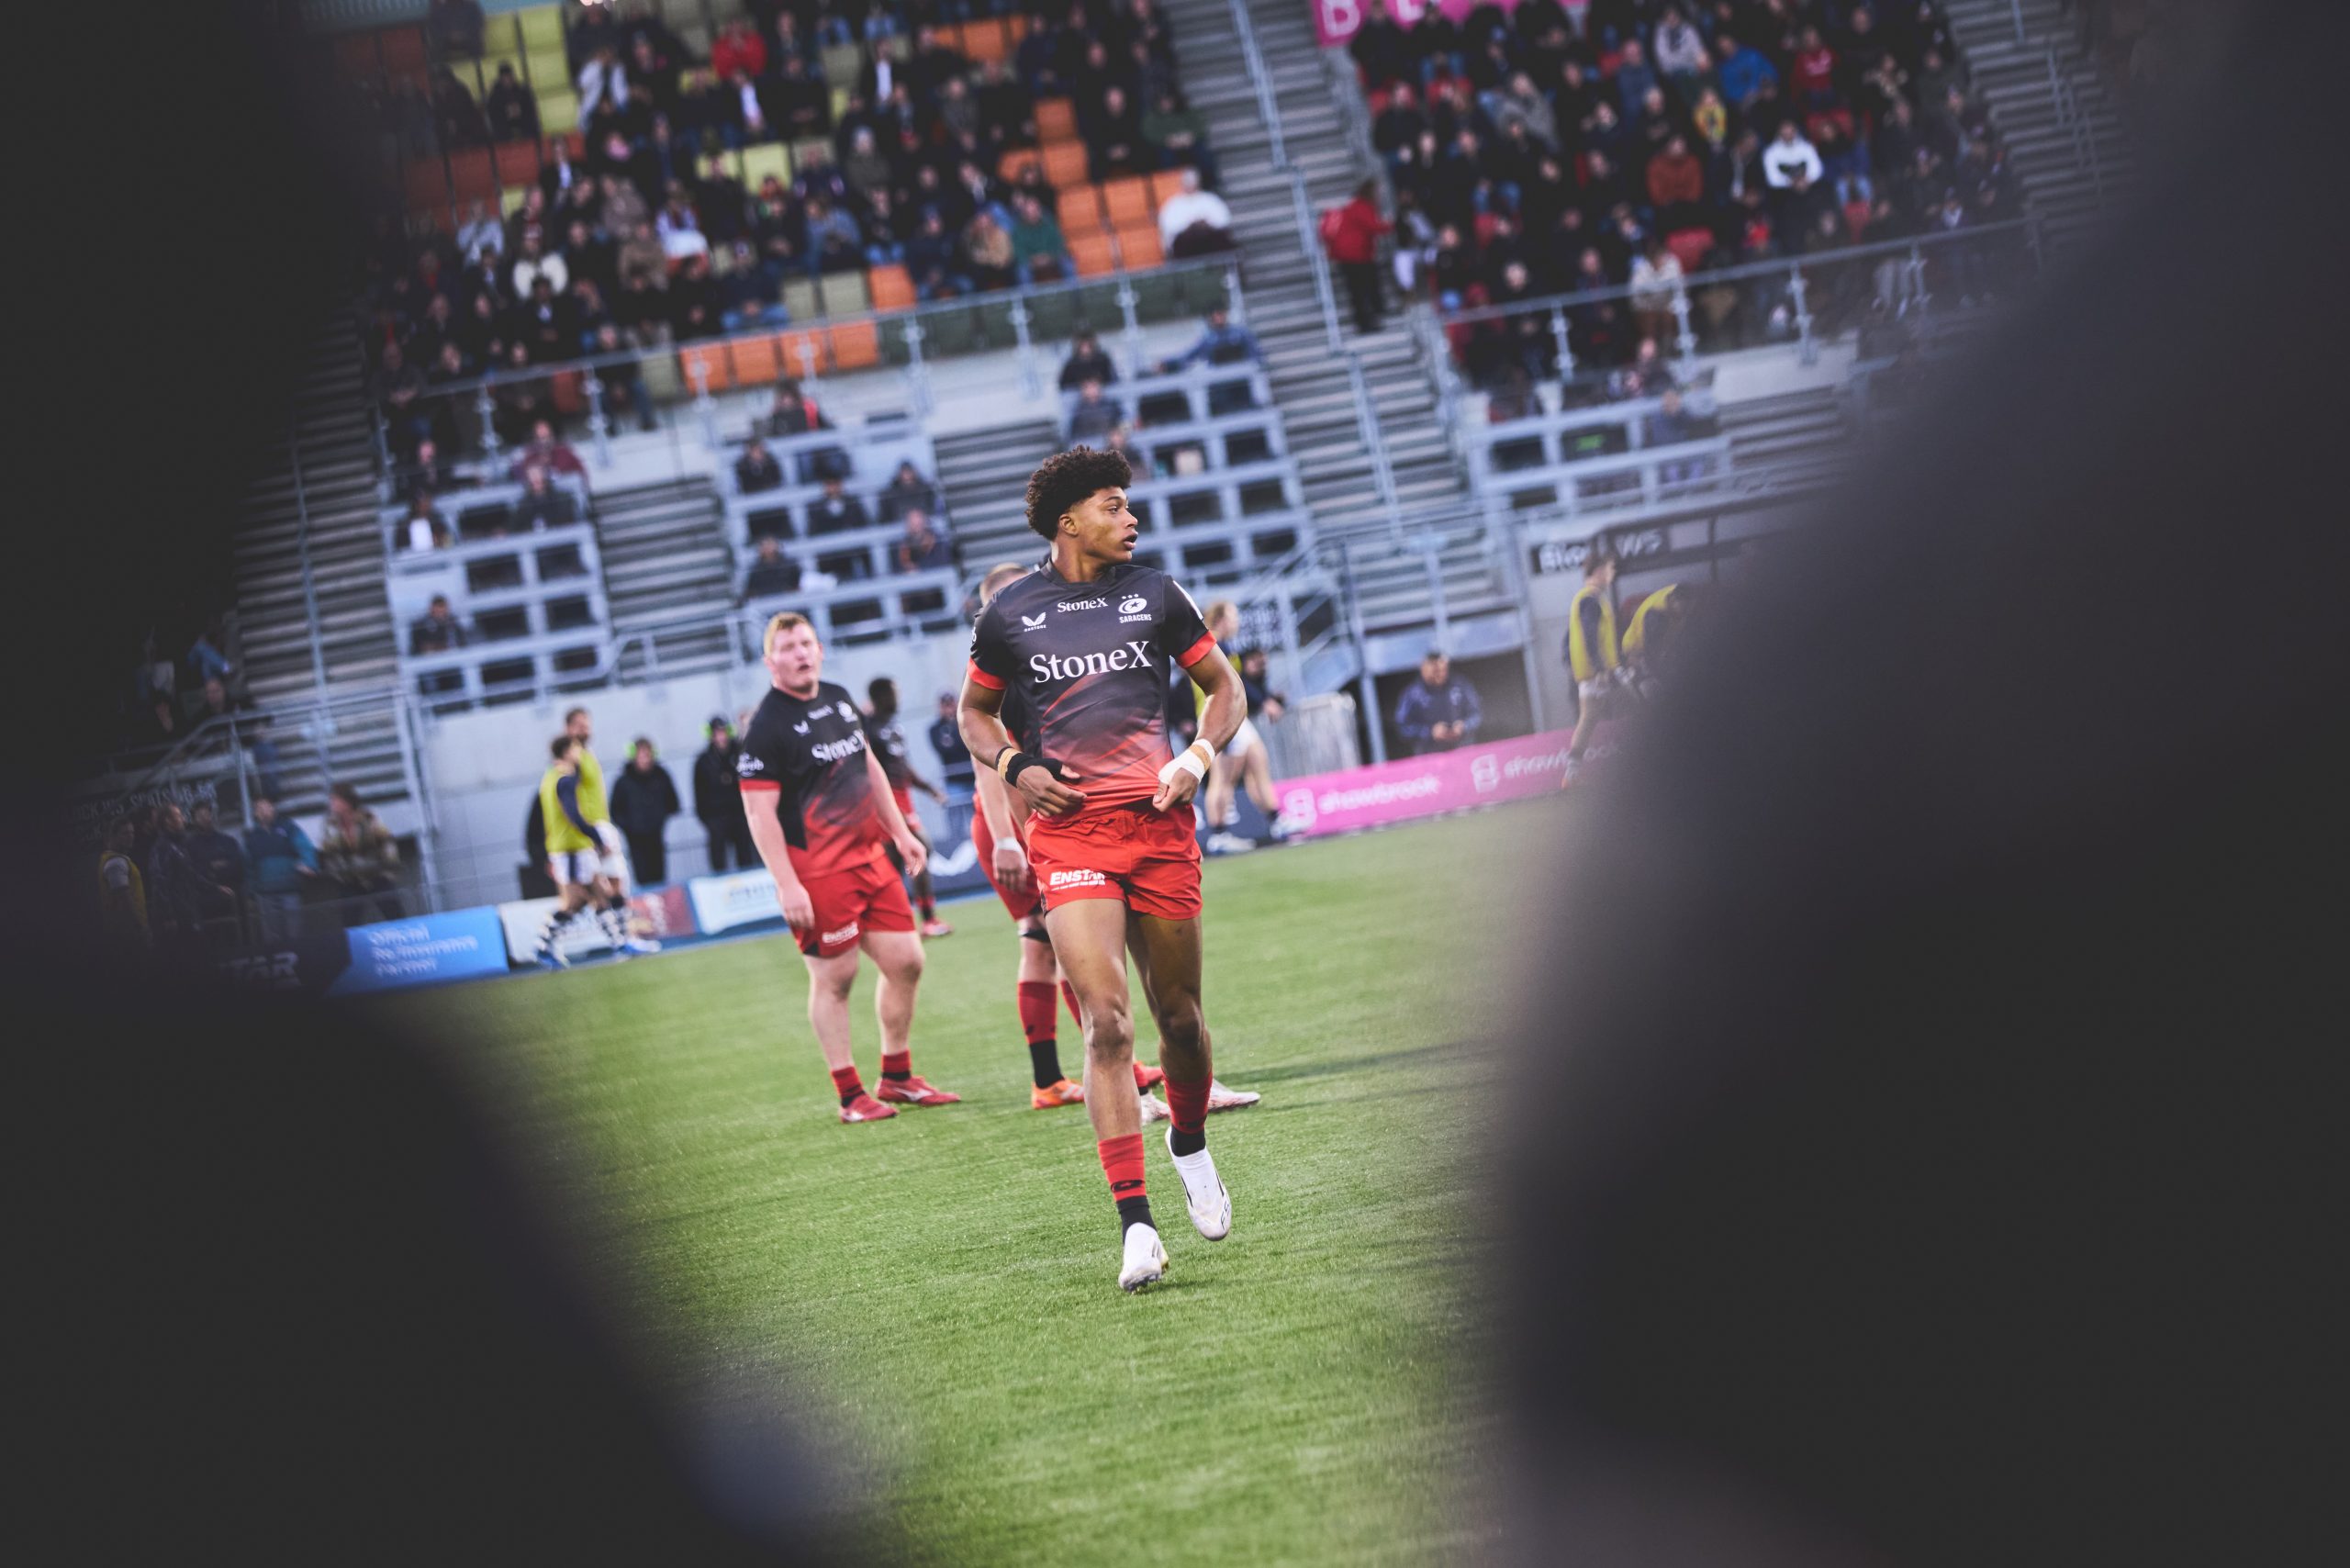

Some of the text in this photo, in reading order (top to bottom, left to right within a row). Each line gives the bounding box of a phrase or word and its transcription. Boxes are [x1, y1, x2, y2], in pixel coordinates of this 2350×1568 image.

[1057, 597, 1109, 613] StoneX
[1119, 613, 1152, 623] SARACENS
[1029, 640, 1152, 683] StoneX
